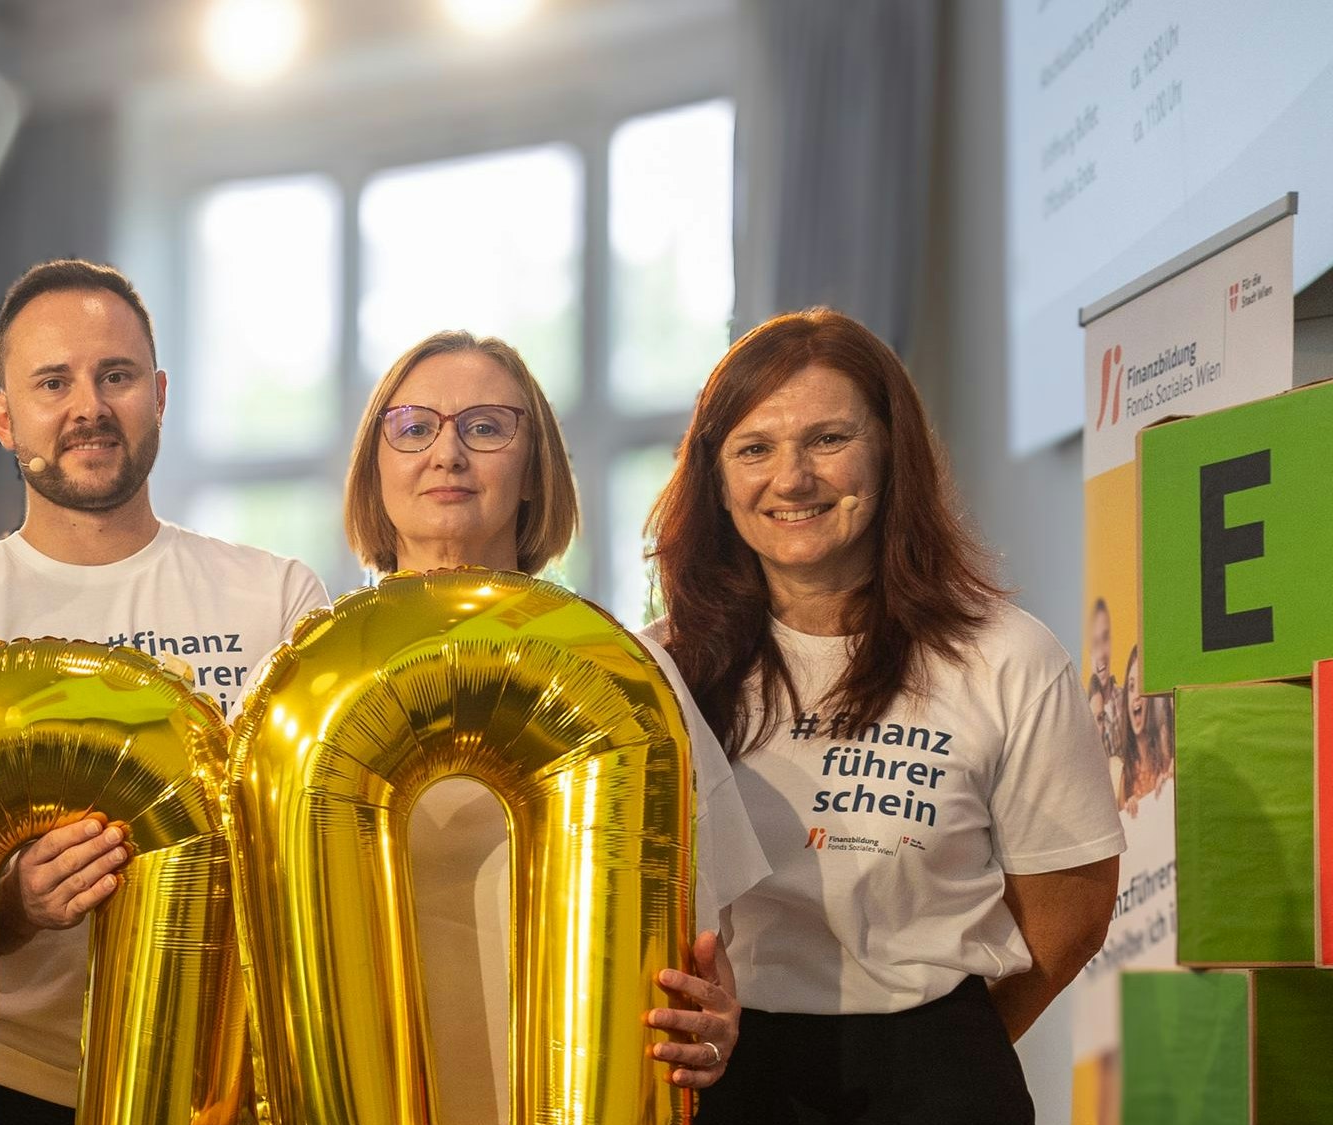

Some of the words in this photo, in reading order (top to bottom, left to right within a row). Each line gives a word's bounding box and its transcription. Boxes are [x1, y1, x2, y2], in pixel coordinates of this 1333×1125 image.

[1257, 285, 1273, 300] Wien
[1127, 341, 1197, 389] Finanzbildung
[1126, 388, 1154, 418] Fonds
[1155, 373, 1194, 406] Soziales
[1195, 360, 1222, 387] Wien
[1199, 448, 1275, 653] E
[822, 746, 946, 790] führer
[812, 784, 937, 827] schein
[827, 843, 847, 851] Fonds
[848, 844, 876, 853] Soziales
[877, 847, 894, 856] Wien
[828, 835, 880, 847] Finanzbildung
